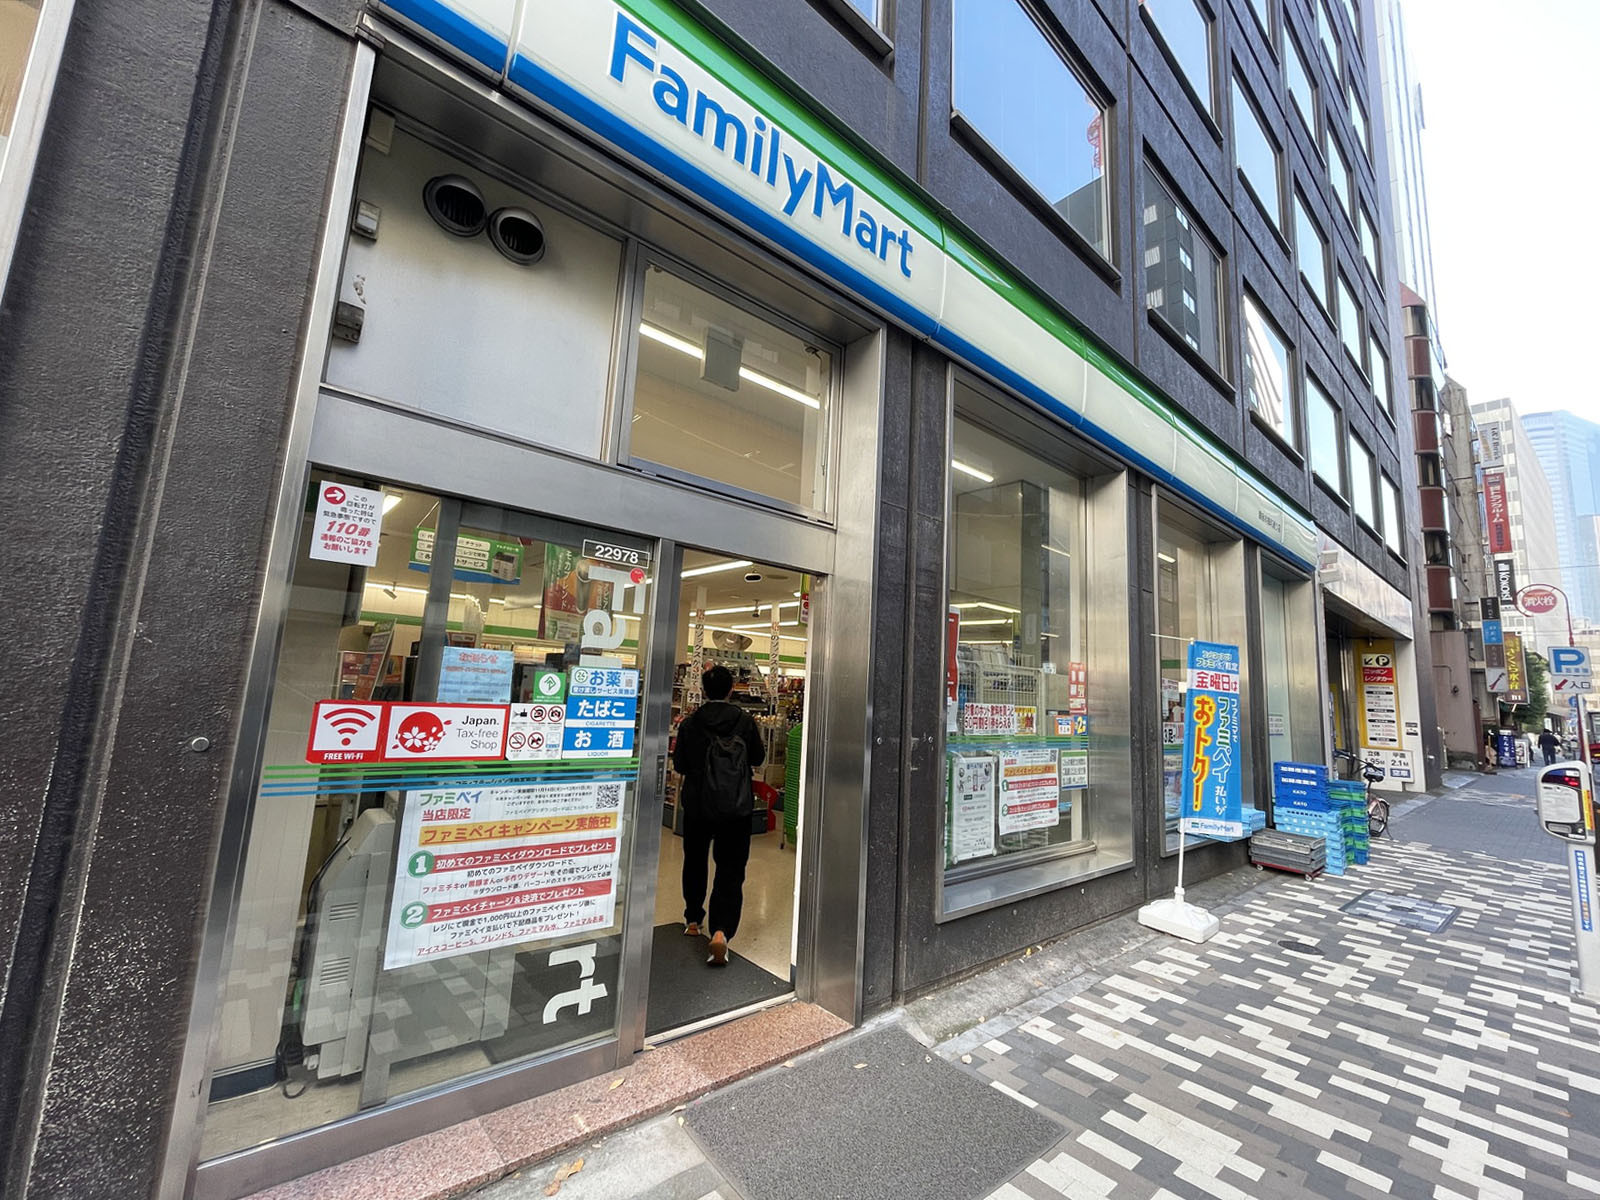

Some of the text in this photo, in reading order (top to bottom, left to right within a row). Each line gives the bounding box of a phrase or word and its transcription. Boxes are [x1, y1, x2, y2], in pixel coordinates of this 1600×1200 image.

[610, 11, 913, 277] FamilyMart
[326, 520, 371, 537] 110番
[320, 533, 373, 548] 通報のご協力を
[323, 543, 369, 555] お願いします
[594, 545, 639, 564] 22978
[1552, 649, 1585, 673] P
[589, 671, 622, 687] お薬
[1195, 671, 1238, 692] 金曜日は
[1570, 680, 1591, 690] 入口
[577, 699, 626, 718] たばこ
[461, 714, 500, 729] Japan.
[456, 728, 500, 740] Tax-free
[470, 739, 498, 751] Shop
[323, 752, 342, 761] FREE
[420, 790, 483, 806] ファミペイ
[421, 807, 472, 822] 当店限定
[422, 816, 612, 844] ファミペイキャンペーン実施中
[1200, 822, 1235, 833] FamilyMart
[436, 841, 613, 871] 初めてのファミペイダウンロードでプレゼント
[415, 855, 428, 874] 1
[404, 905, 423, 924] 2
